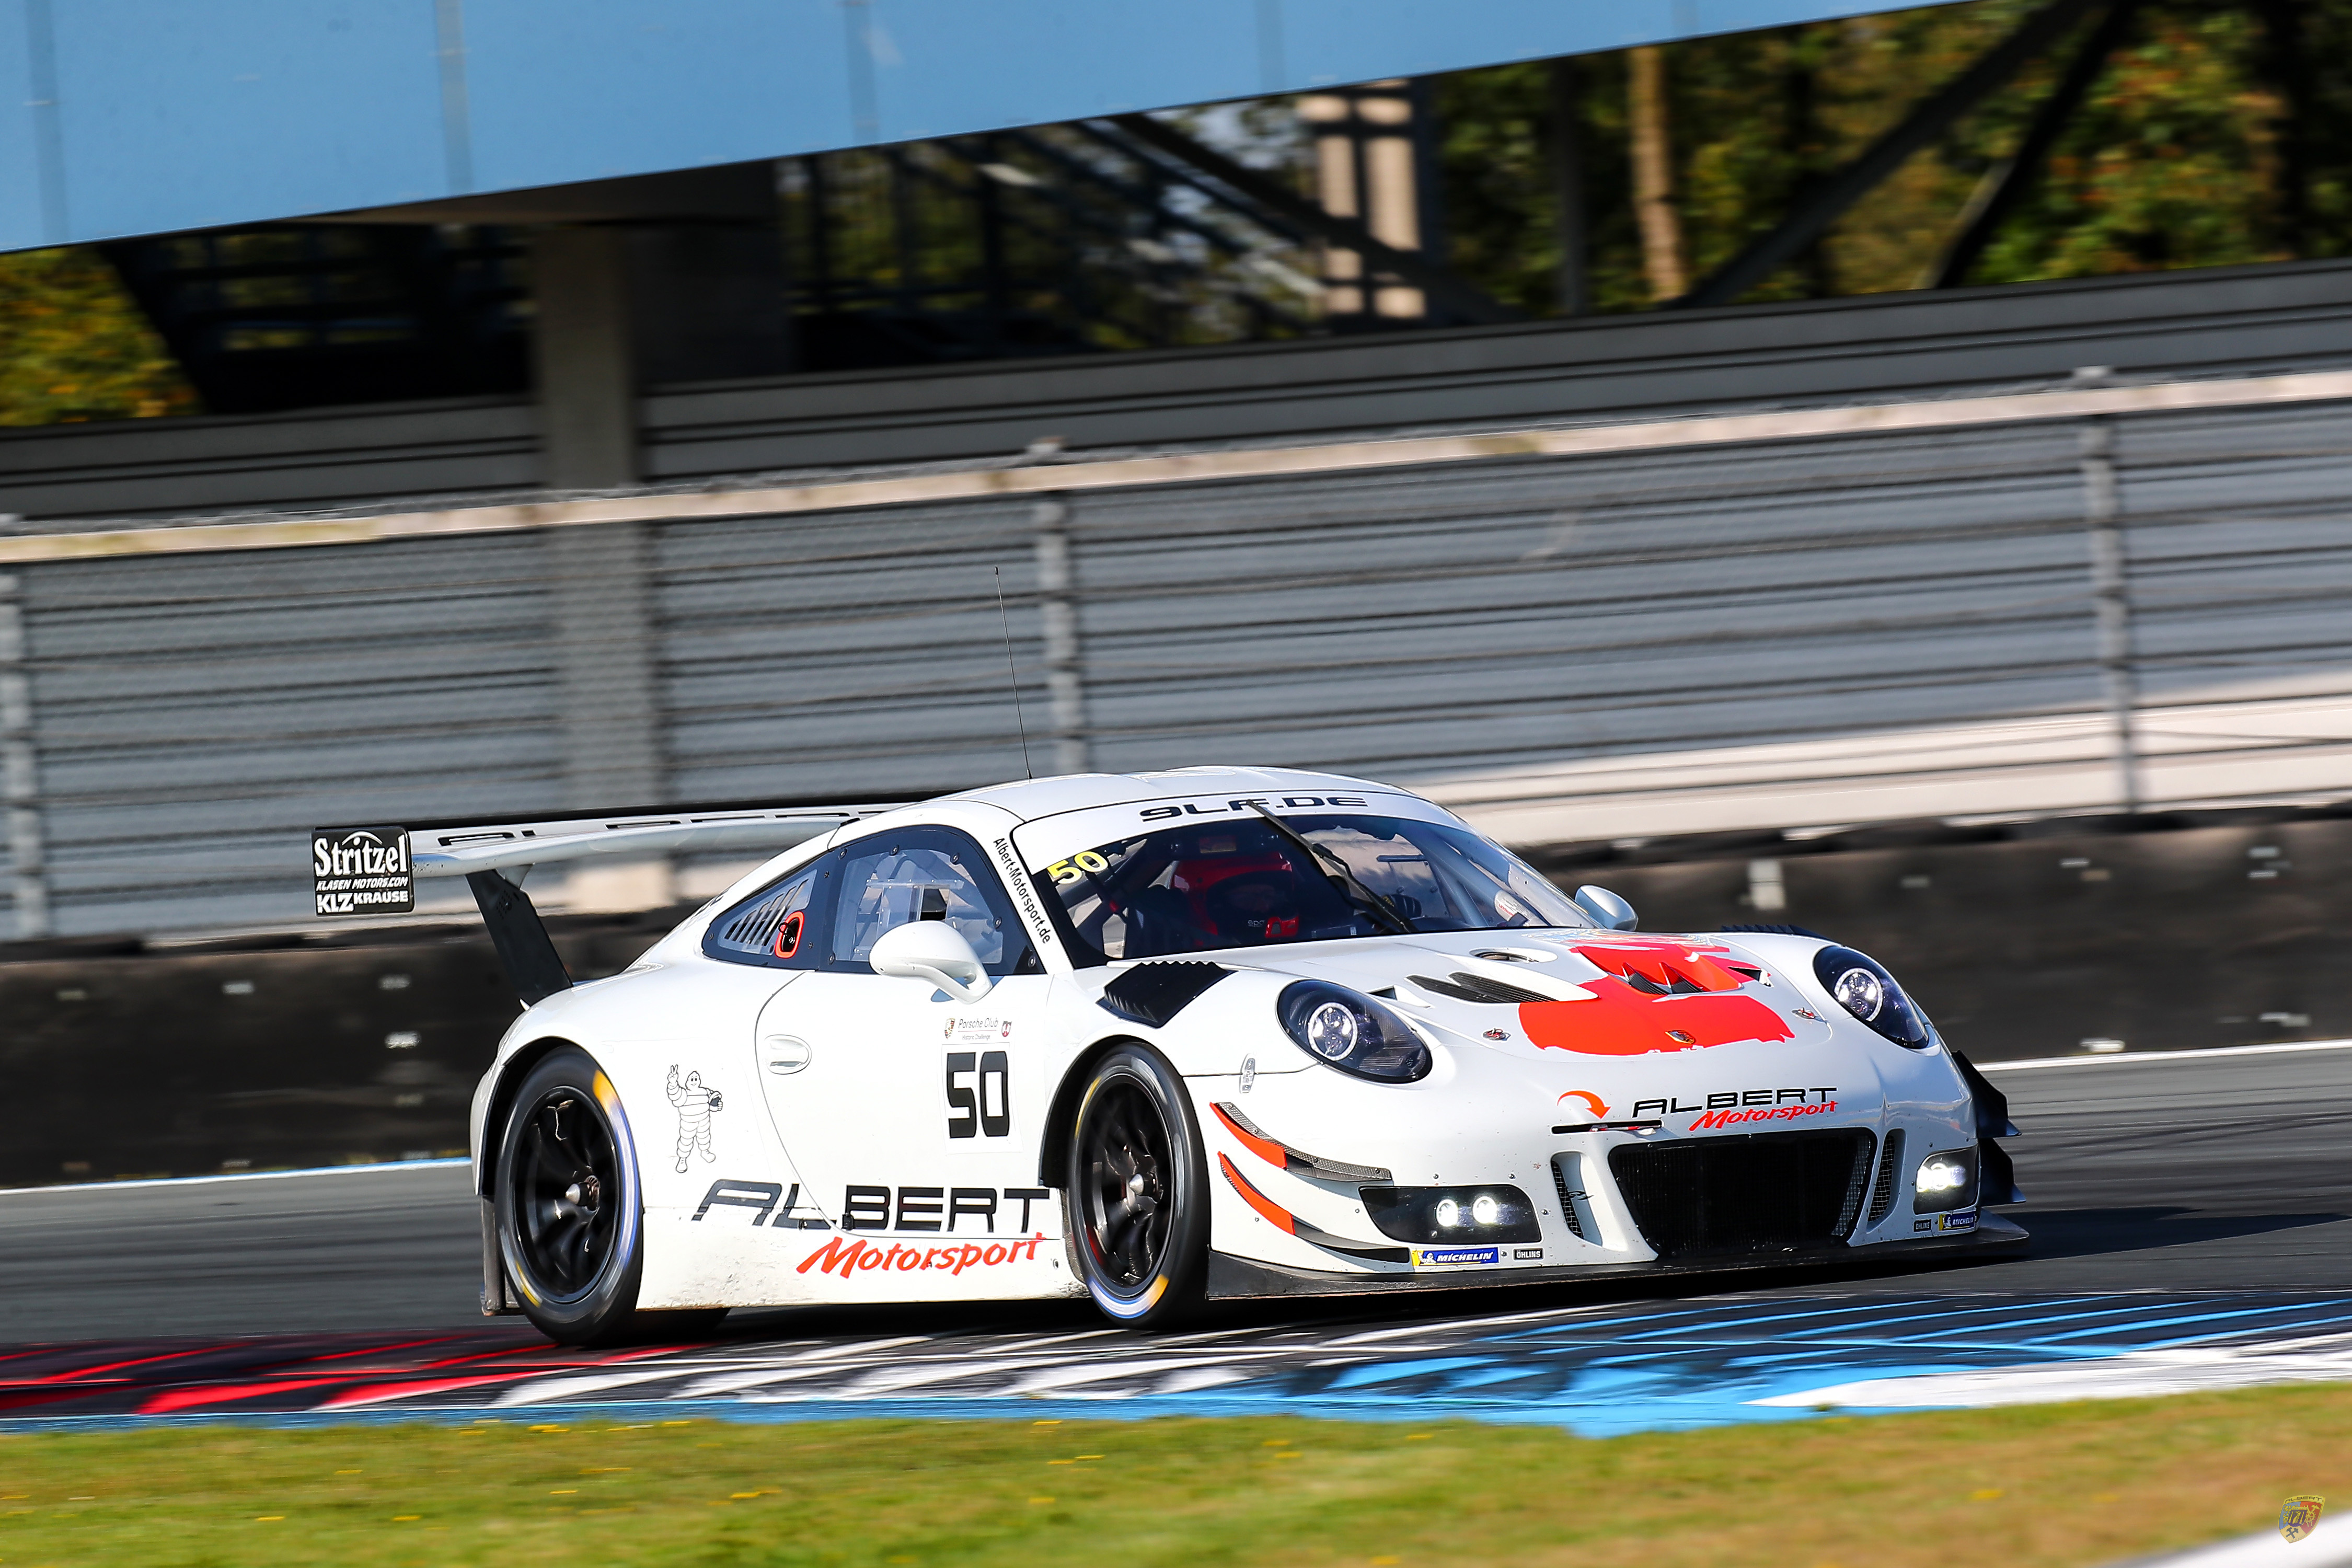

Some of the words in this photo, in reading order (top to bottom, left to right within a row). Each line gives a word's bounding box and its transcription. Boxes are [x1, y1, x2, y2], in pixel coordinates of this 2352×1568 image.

[315, 834, 407, 877] Stritzel
[1047, 851, 1108, 884] 50
[317, 893, 354, 913] KLZ
[353, 891, 409, 904] KRAUSE
[993, 838, 1051, 944] Albert-Motorsport.de
[958, 1018, 983, 1029] Porsche
[984, 1018, 998, 1028] Club
[947, 1051, 1010, 1139] 50
[1632, 1087, 1837, 1119] ALBERT
[1689, 1100, 1838, 1132] Motorsport
[691, 1179, 1050, 1233] ALBERT
[796, 1232, 1046, 1278] Motorsport
[1437, 1251, 1494, 1262] MICHELIN
[1516, 1250, 1540, 1259] ÖHLINS
